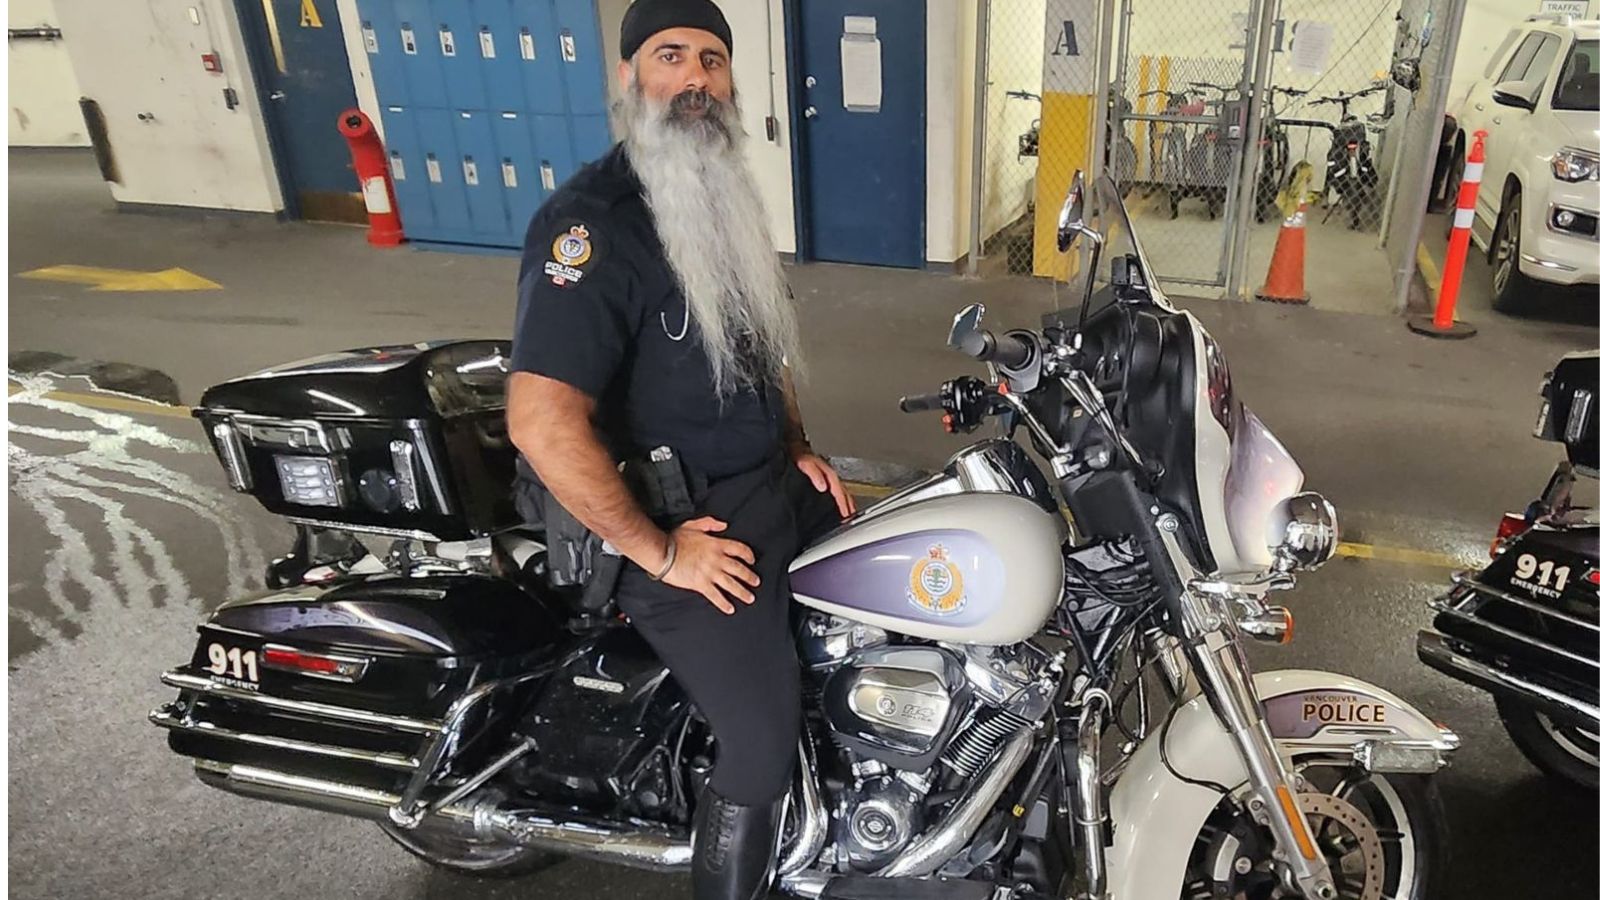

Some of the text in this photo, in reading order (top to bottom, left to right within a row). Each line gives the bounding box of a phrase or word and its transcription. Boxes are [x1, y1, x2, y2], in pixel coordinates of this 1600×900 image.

[300, 0, 323, 28] A
[1547, 3, 1581, 12] TRAFFIC
[1051, 20, 1080, 56] A
[544, 260, 583, 279] POLICE
[1515, 553, 1571, 591] 911
[1510, 576, 1562, 599] EMERGENCY
[208, 642, 259, 682] 911
[1303, 703, 1385, 723] POLICE
